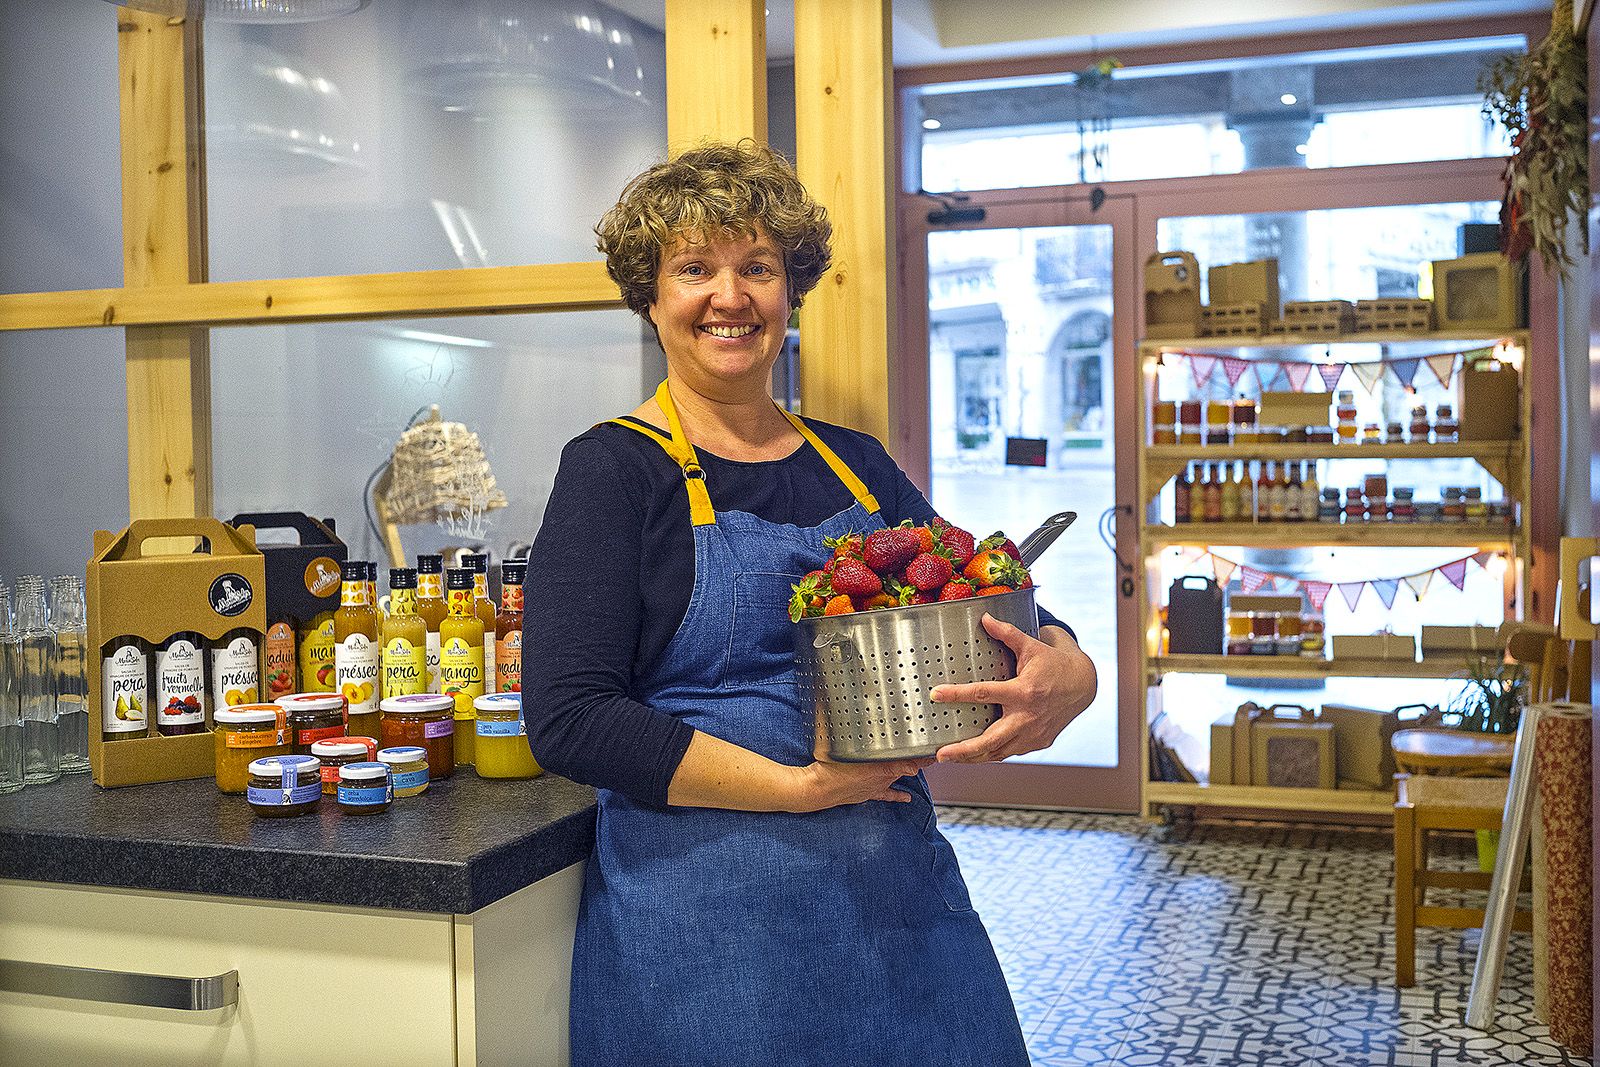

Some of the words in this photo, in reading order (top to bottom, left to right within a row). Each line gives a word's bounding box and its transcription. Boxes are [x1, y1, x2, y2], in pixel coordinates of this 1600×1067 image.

[162, 672, 188, 692] fruits
[338, 664, 378, 686] préssec
[386, 666, 419, 687] pera
[440, 666, 482, 689] mango
[112, 677, 147, 702] pera
